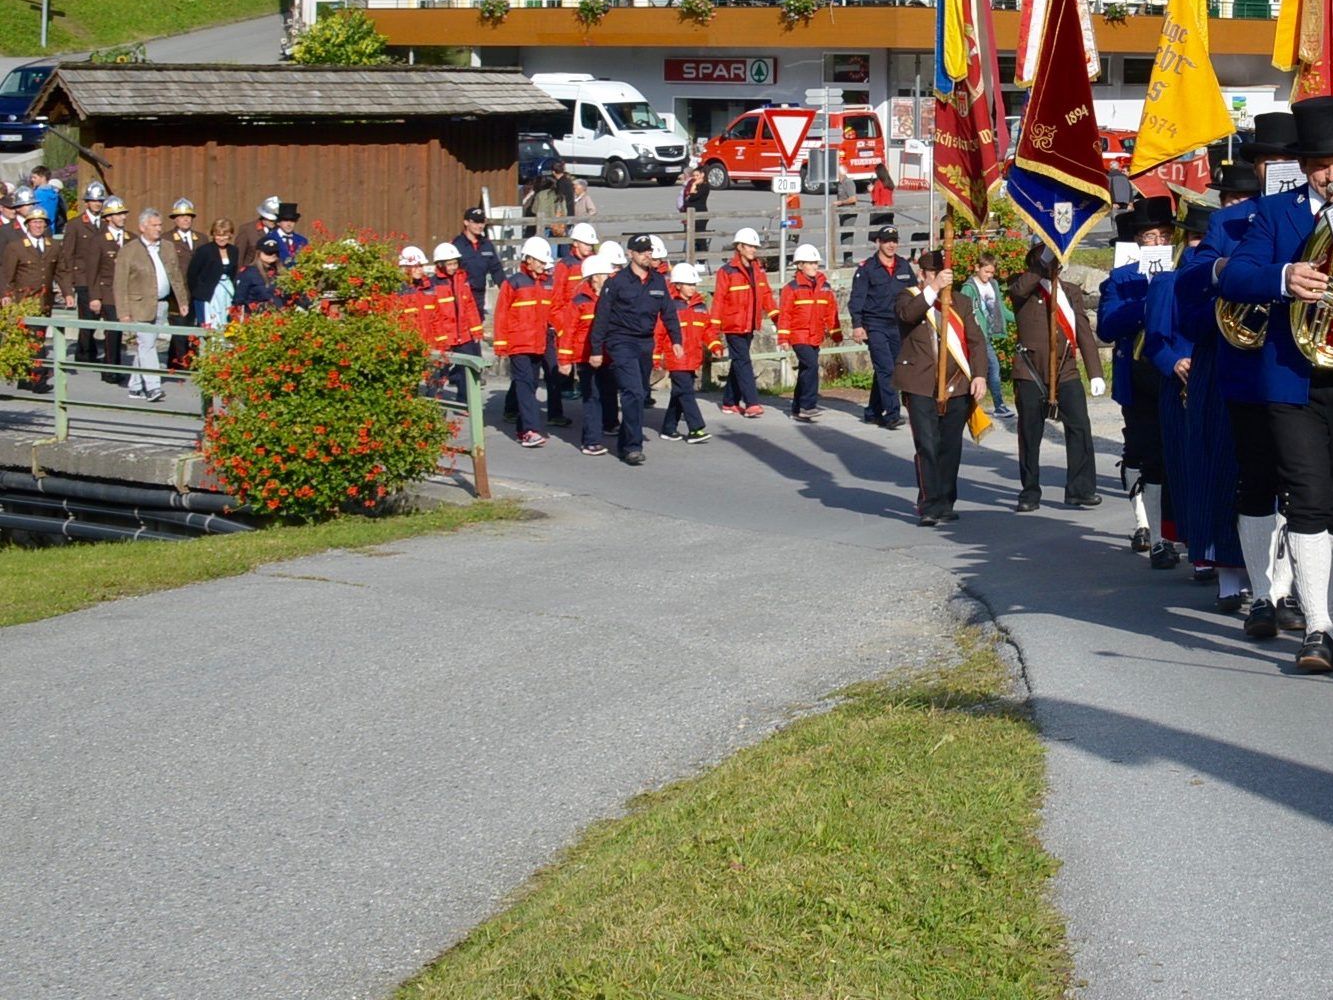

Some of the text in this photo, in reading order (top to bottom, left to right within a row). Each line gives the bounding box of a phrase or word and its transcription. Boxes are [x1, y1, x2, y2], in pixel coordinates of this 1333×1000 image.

[682, 63, 745, 79] SPAR
[1065, 104, 1089, 126] 1894
[778, 178, 797, 190] 20 m
